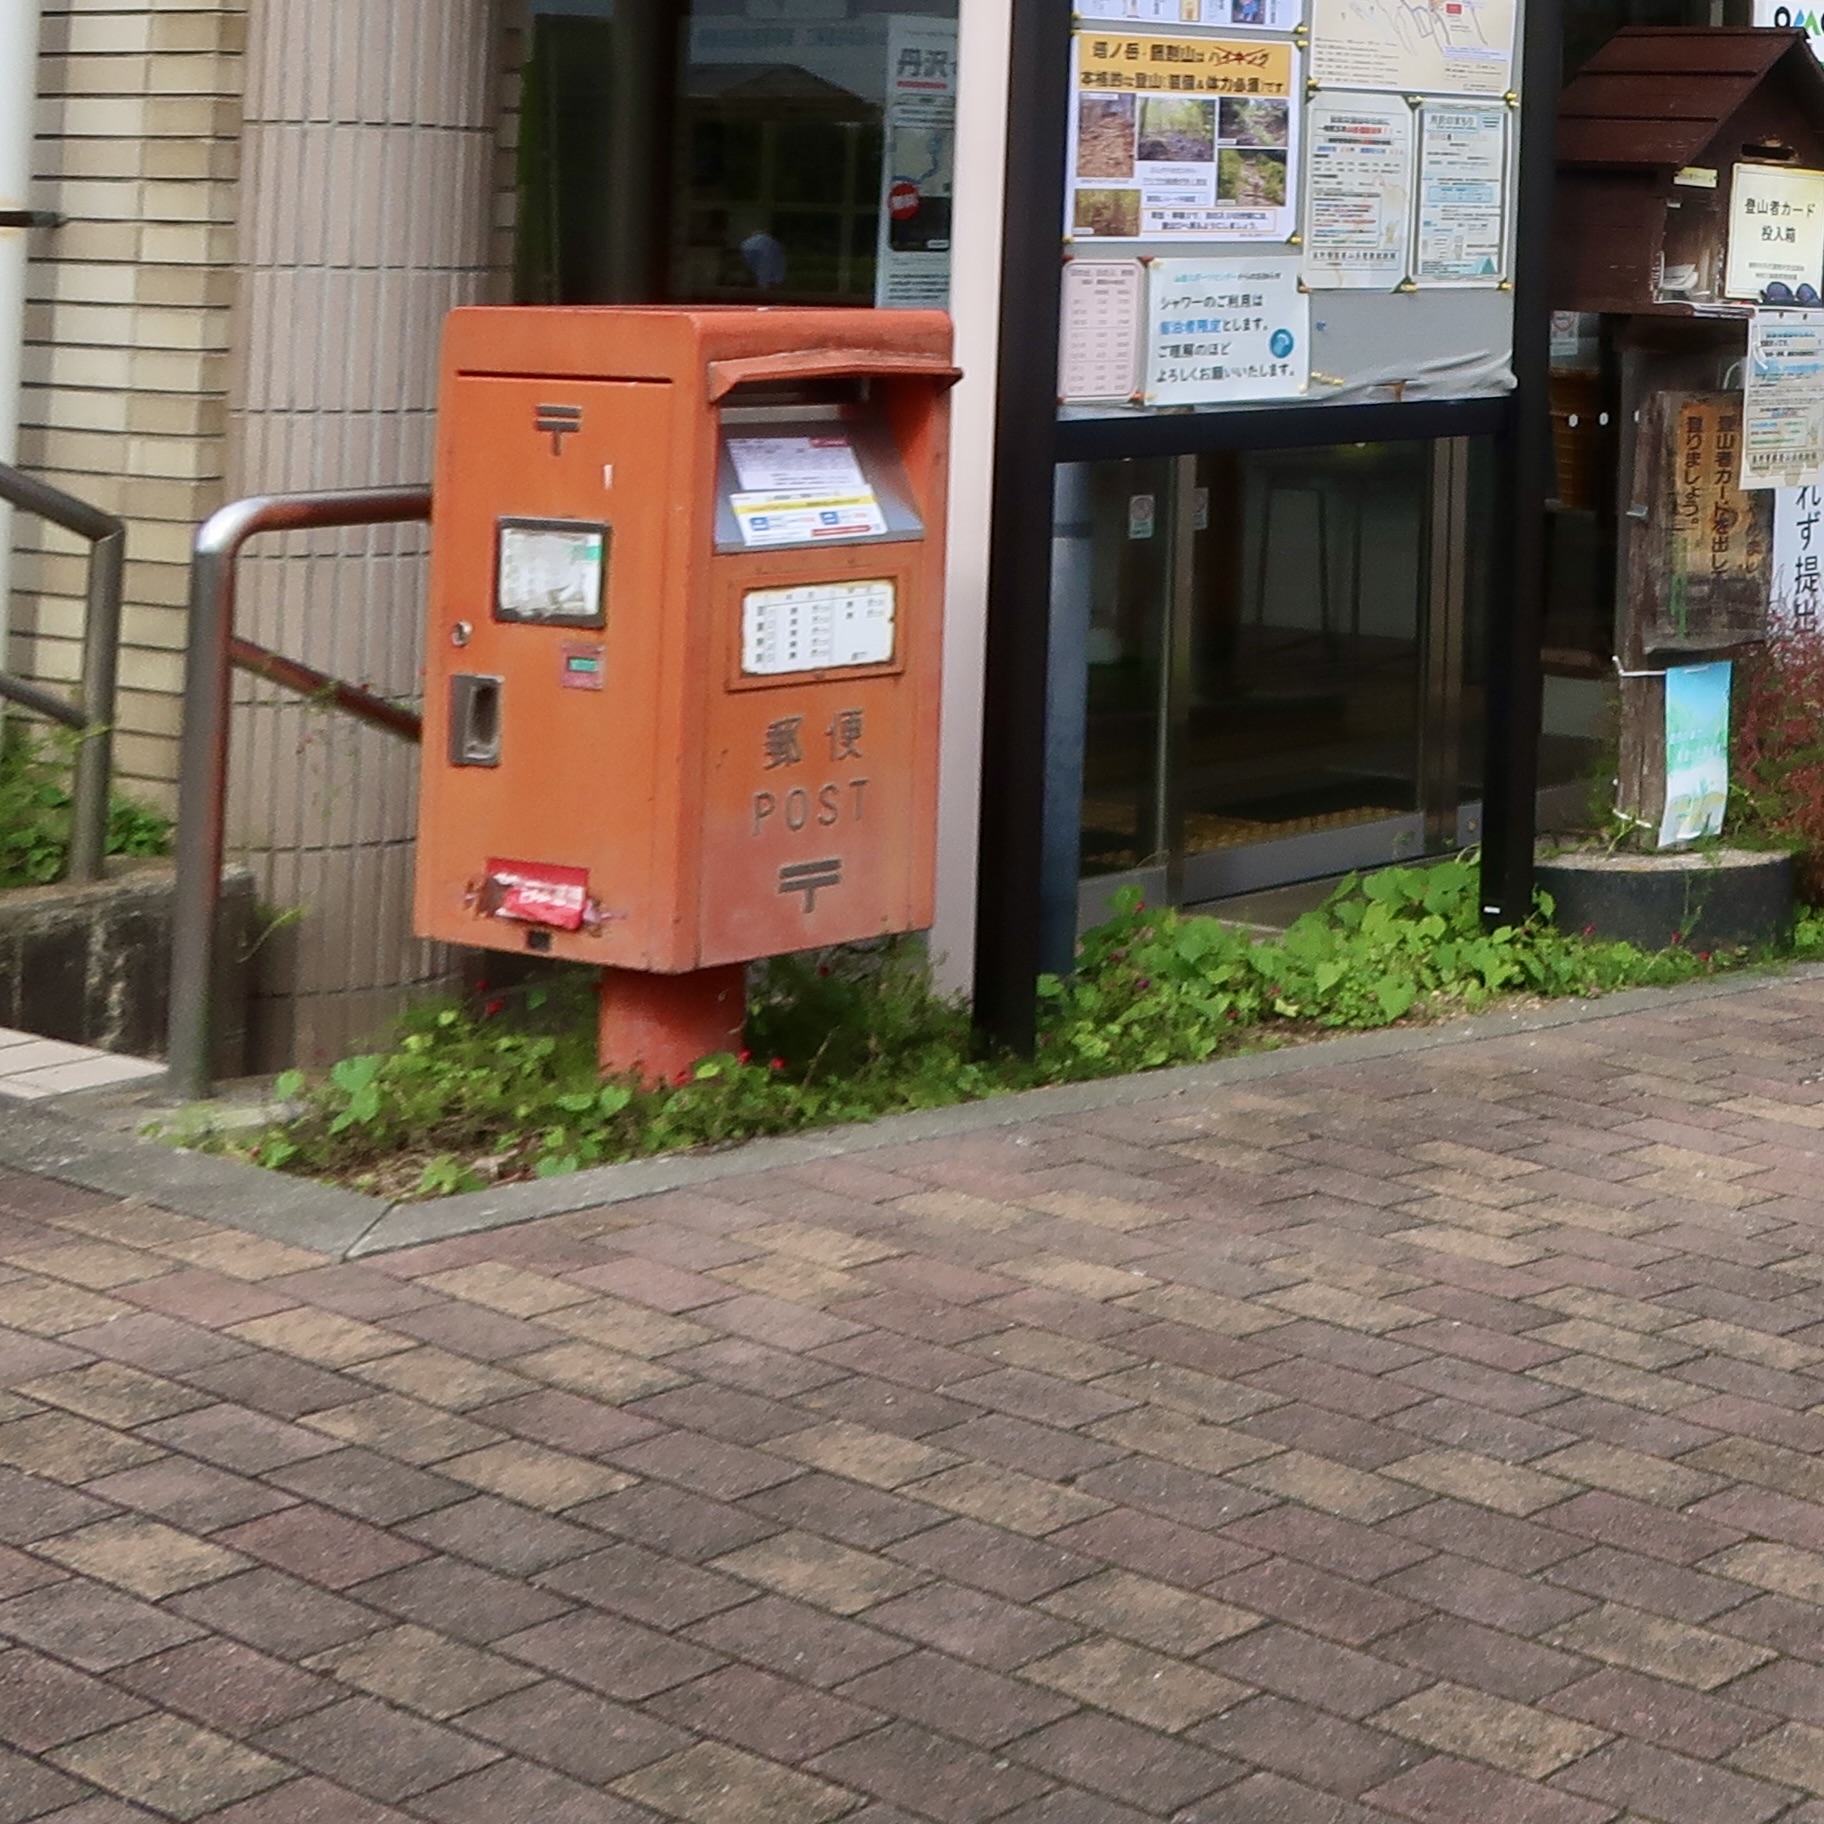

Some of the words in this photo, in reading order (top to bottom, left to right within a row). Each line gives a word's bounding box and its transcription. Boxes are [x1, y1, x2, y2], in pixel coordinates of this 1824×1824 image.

[1744, 197, 1817, 218] 登山者カード
[1761, 225, 1796, 244] 投入箱
[1160, 293, 1263, 310] シャワーのご利用は
[764, 707, 865, 770] 郵便
[753, 778, 869, 836] POST
